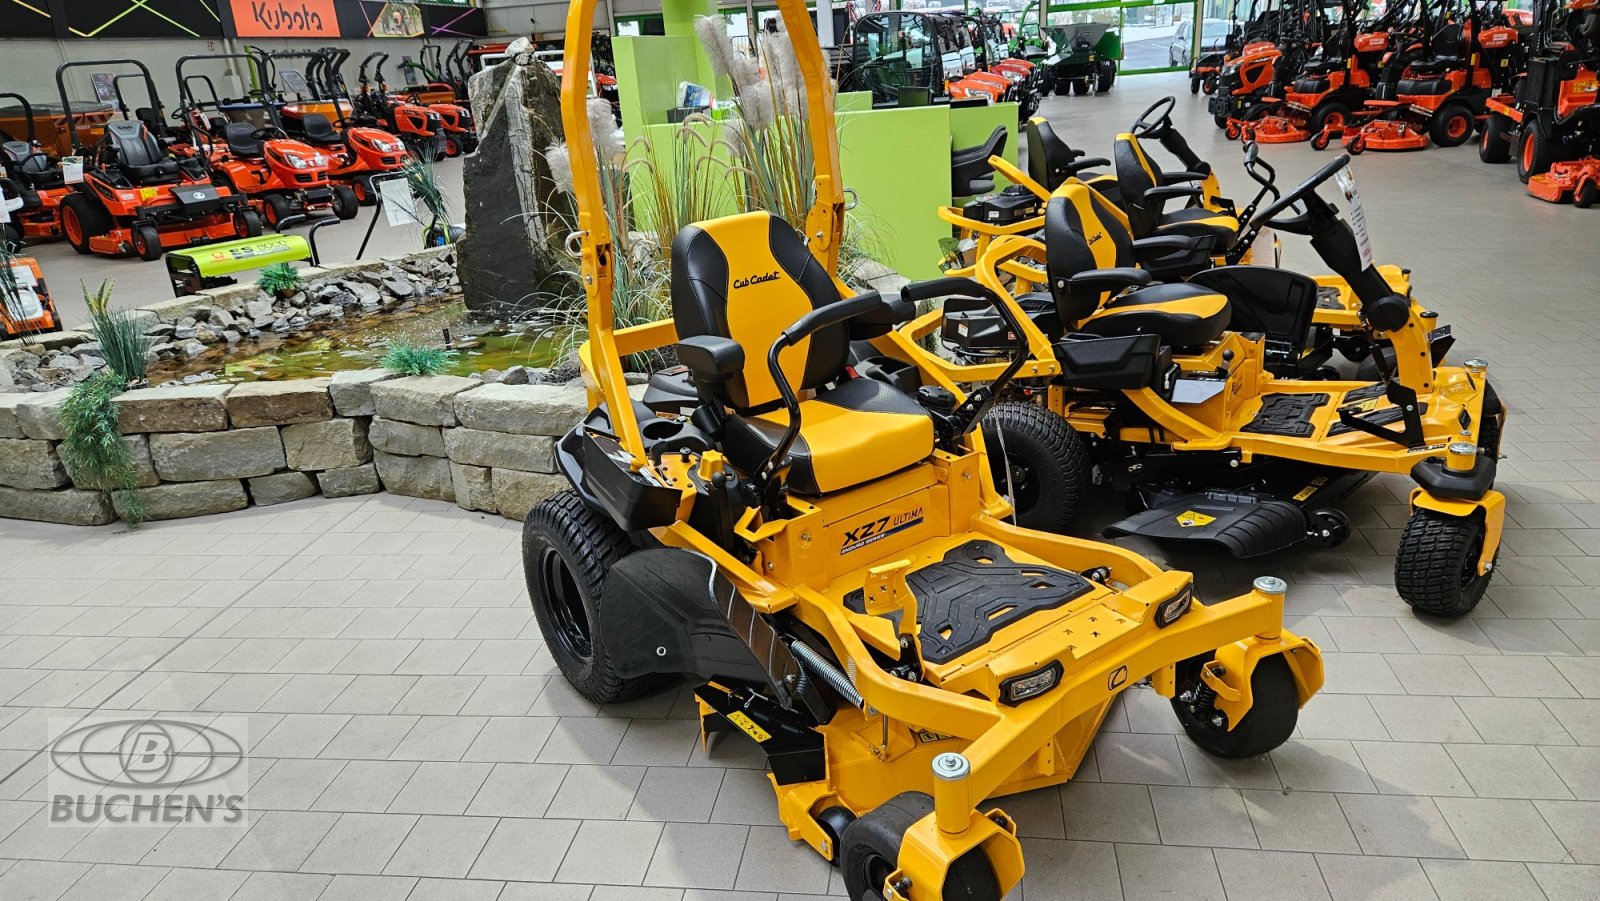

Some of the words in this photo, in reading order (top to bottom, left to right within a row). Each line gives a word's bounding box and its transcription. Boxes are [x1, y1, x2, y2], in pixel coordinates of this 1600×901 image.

[251, 2, 323, 31] Kubota
[733, 277, 750, 289] Cub
[750, 271, 781, 285] Cadet
[842, 516, 891, 546] XZ7
[893, 507, 923, 526] ULTIMA
